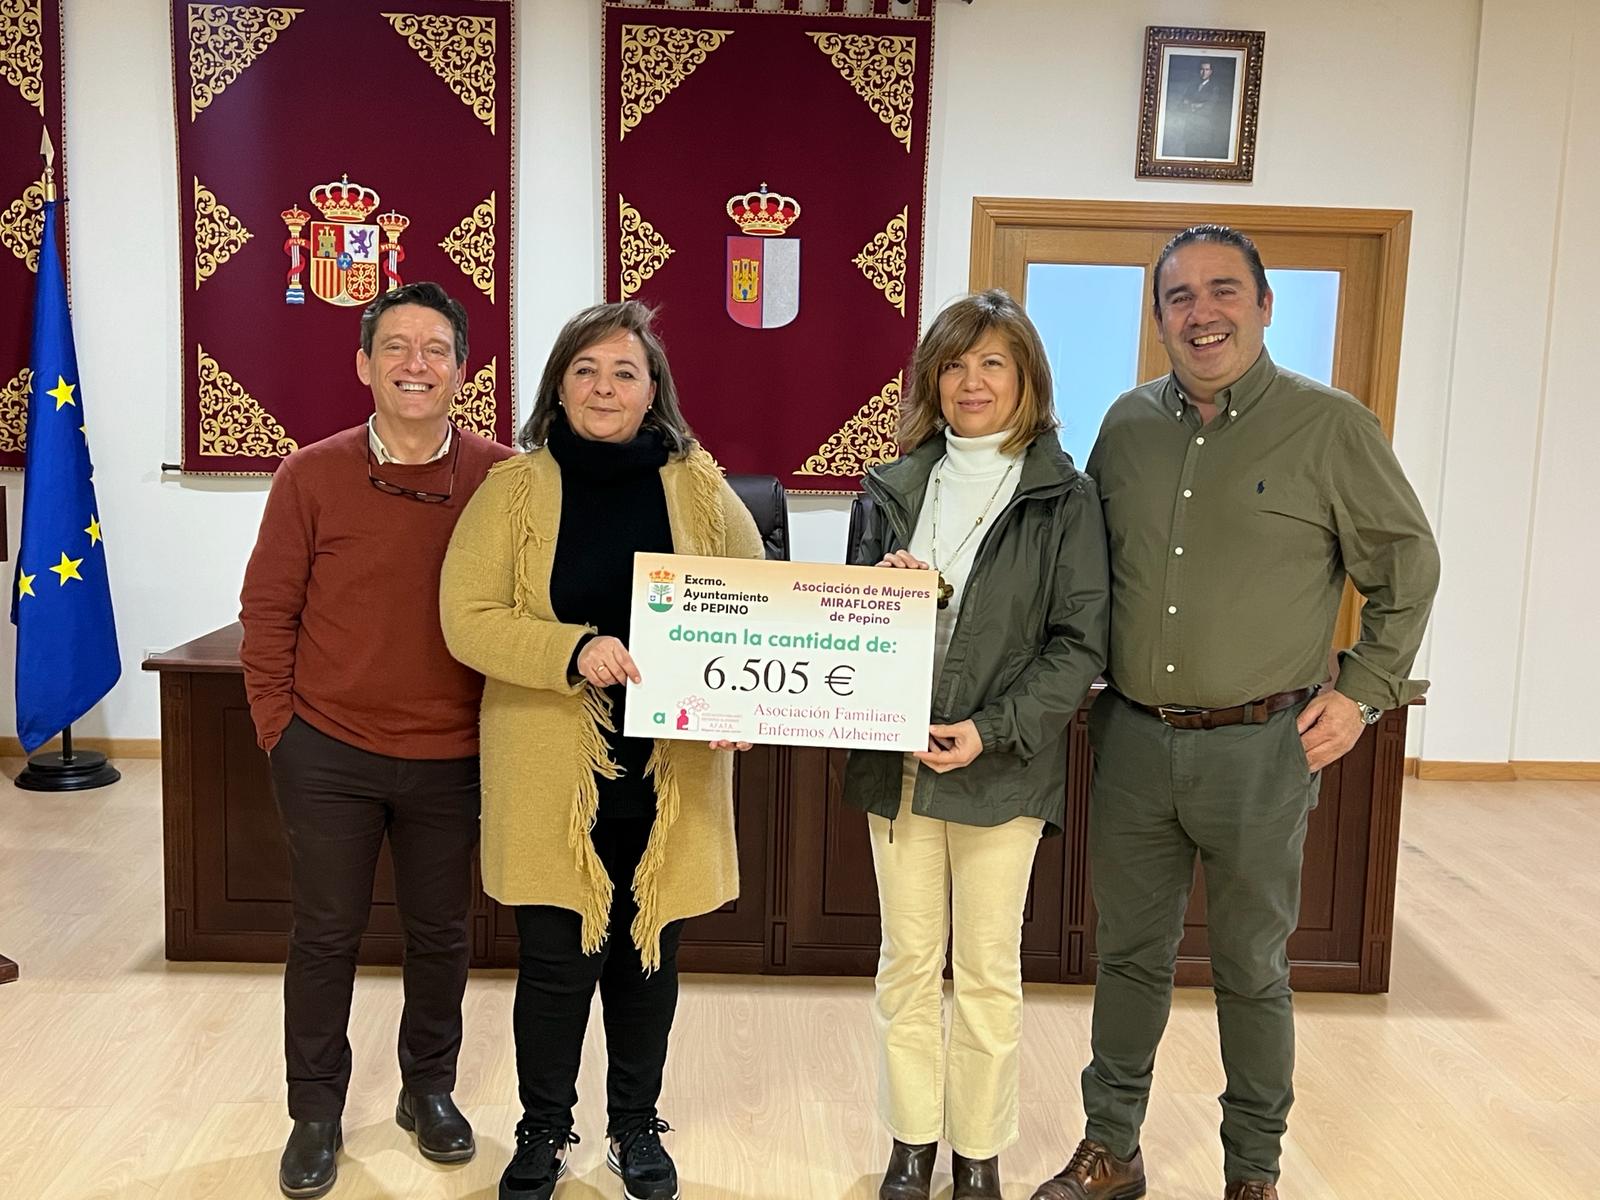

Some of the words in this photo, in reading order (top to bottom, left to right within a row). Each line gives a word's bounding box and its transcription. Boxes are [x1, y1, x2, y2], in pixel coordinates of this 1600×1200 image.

[685, 574, 726, 587] Excmo.
[684, 588, 769, 602] Ayuntamiento
[793, 581, 860, 595] Asociación
[863, 585, 878, 595] de
[881, 586, 930, 599] Mujeres
[683, 602, 697, 612] de
[701, 603, 748, 615] PEPINO
[820, 597, 901, 611] MIRAFLORES
[829, 612, 845, 621] de
[848, 613, 890, 625] Pepino
[669, 625, 737, 644] donan
[743, 629, 762, 645] la
[768, 632, 860, 651] cantidad
[866, 636, 898, 653] de:
[704, 656, 809, 694] 6.505
[824, 664, 856, 696] €
[653, 712, 666, 724] a
[754, 703, 830, 719] Asociación
[835, 707, 906, 723] Familiares
[758, 723, 825, 738] Enfermos
[829, 727, 901, 742] Alzheimer
